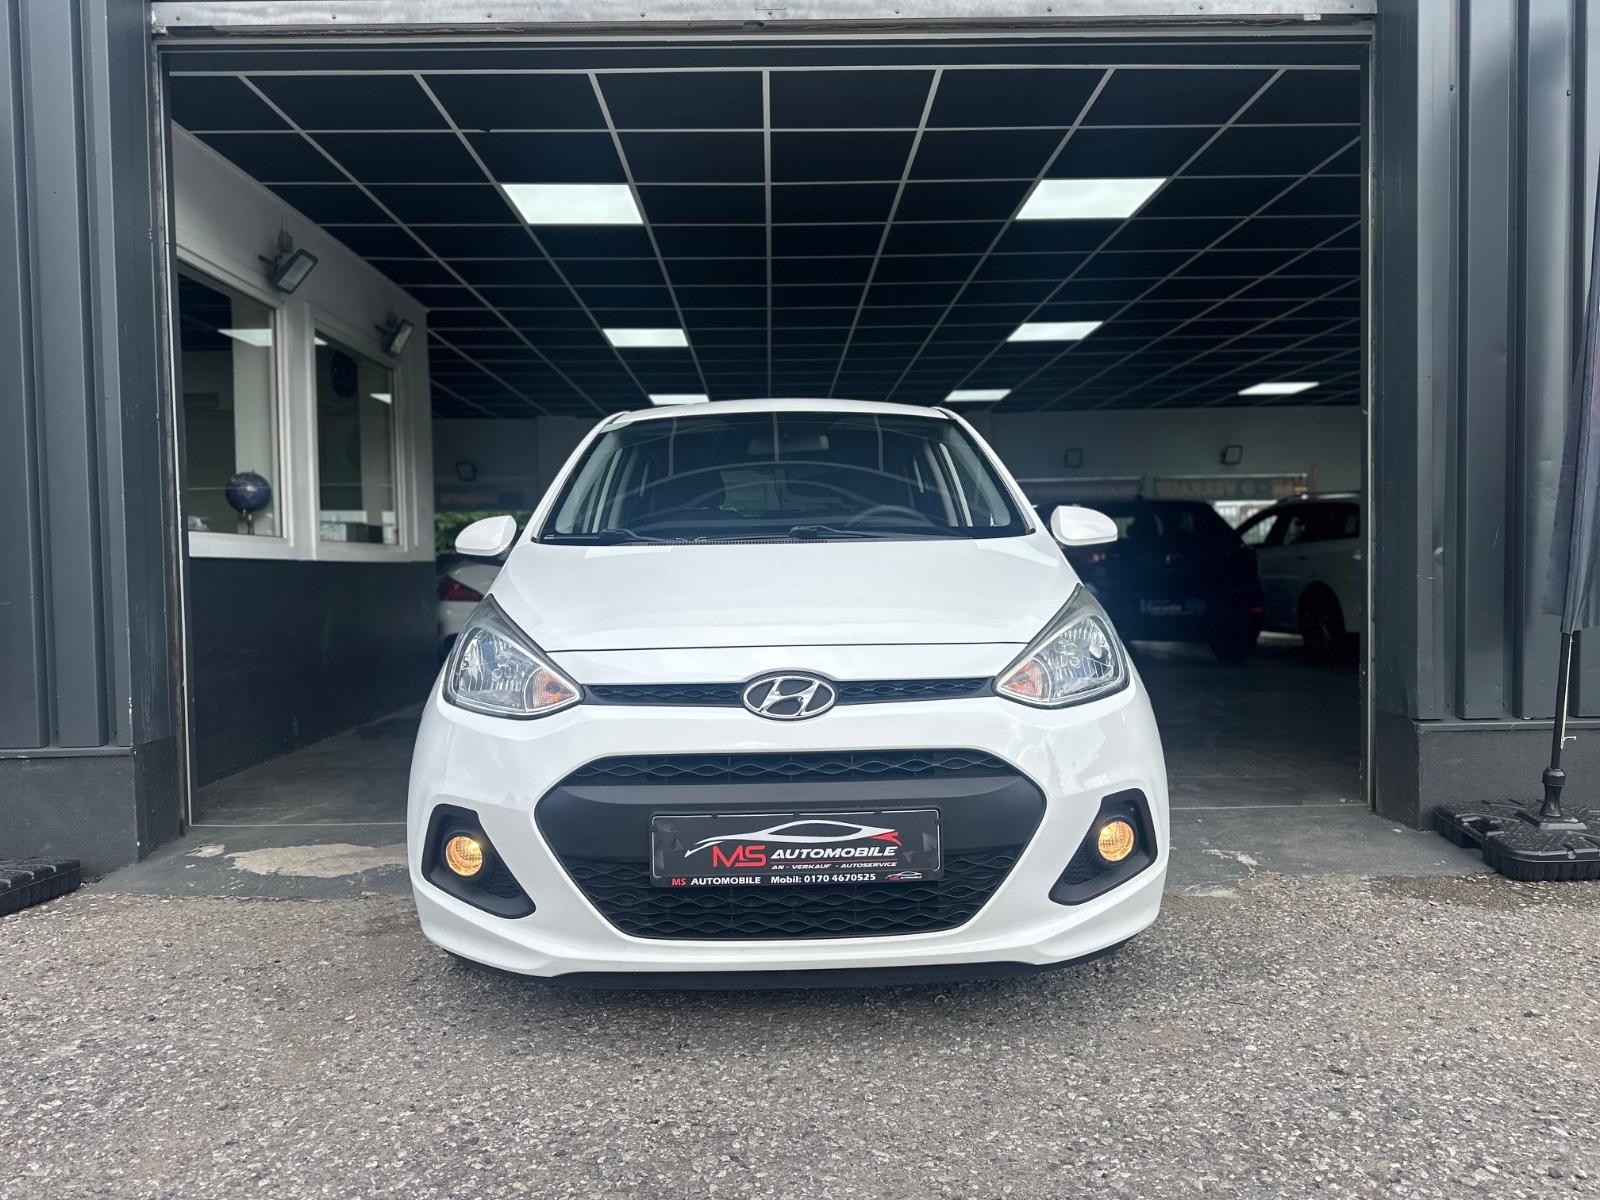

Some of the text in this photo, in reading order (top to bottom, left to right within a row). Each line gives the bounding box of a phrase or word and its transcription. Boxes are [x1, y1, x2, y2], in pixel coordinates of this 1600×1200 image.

[712, 845, 898, 867] MS AUTOMOBILE
[671, 873, 876, 886] MS AUTOMOBILE Mobil: 0170 4670525
